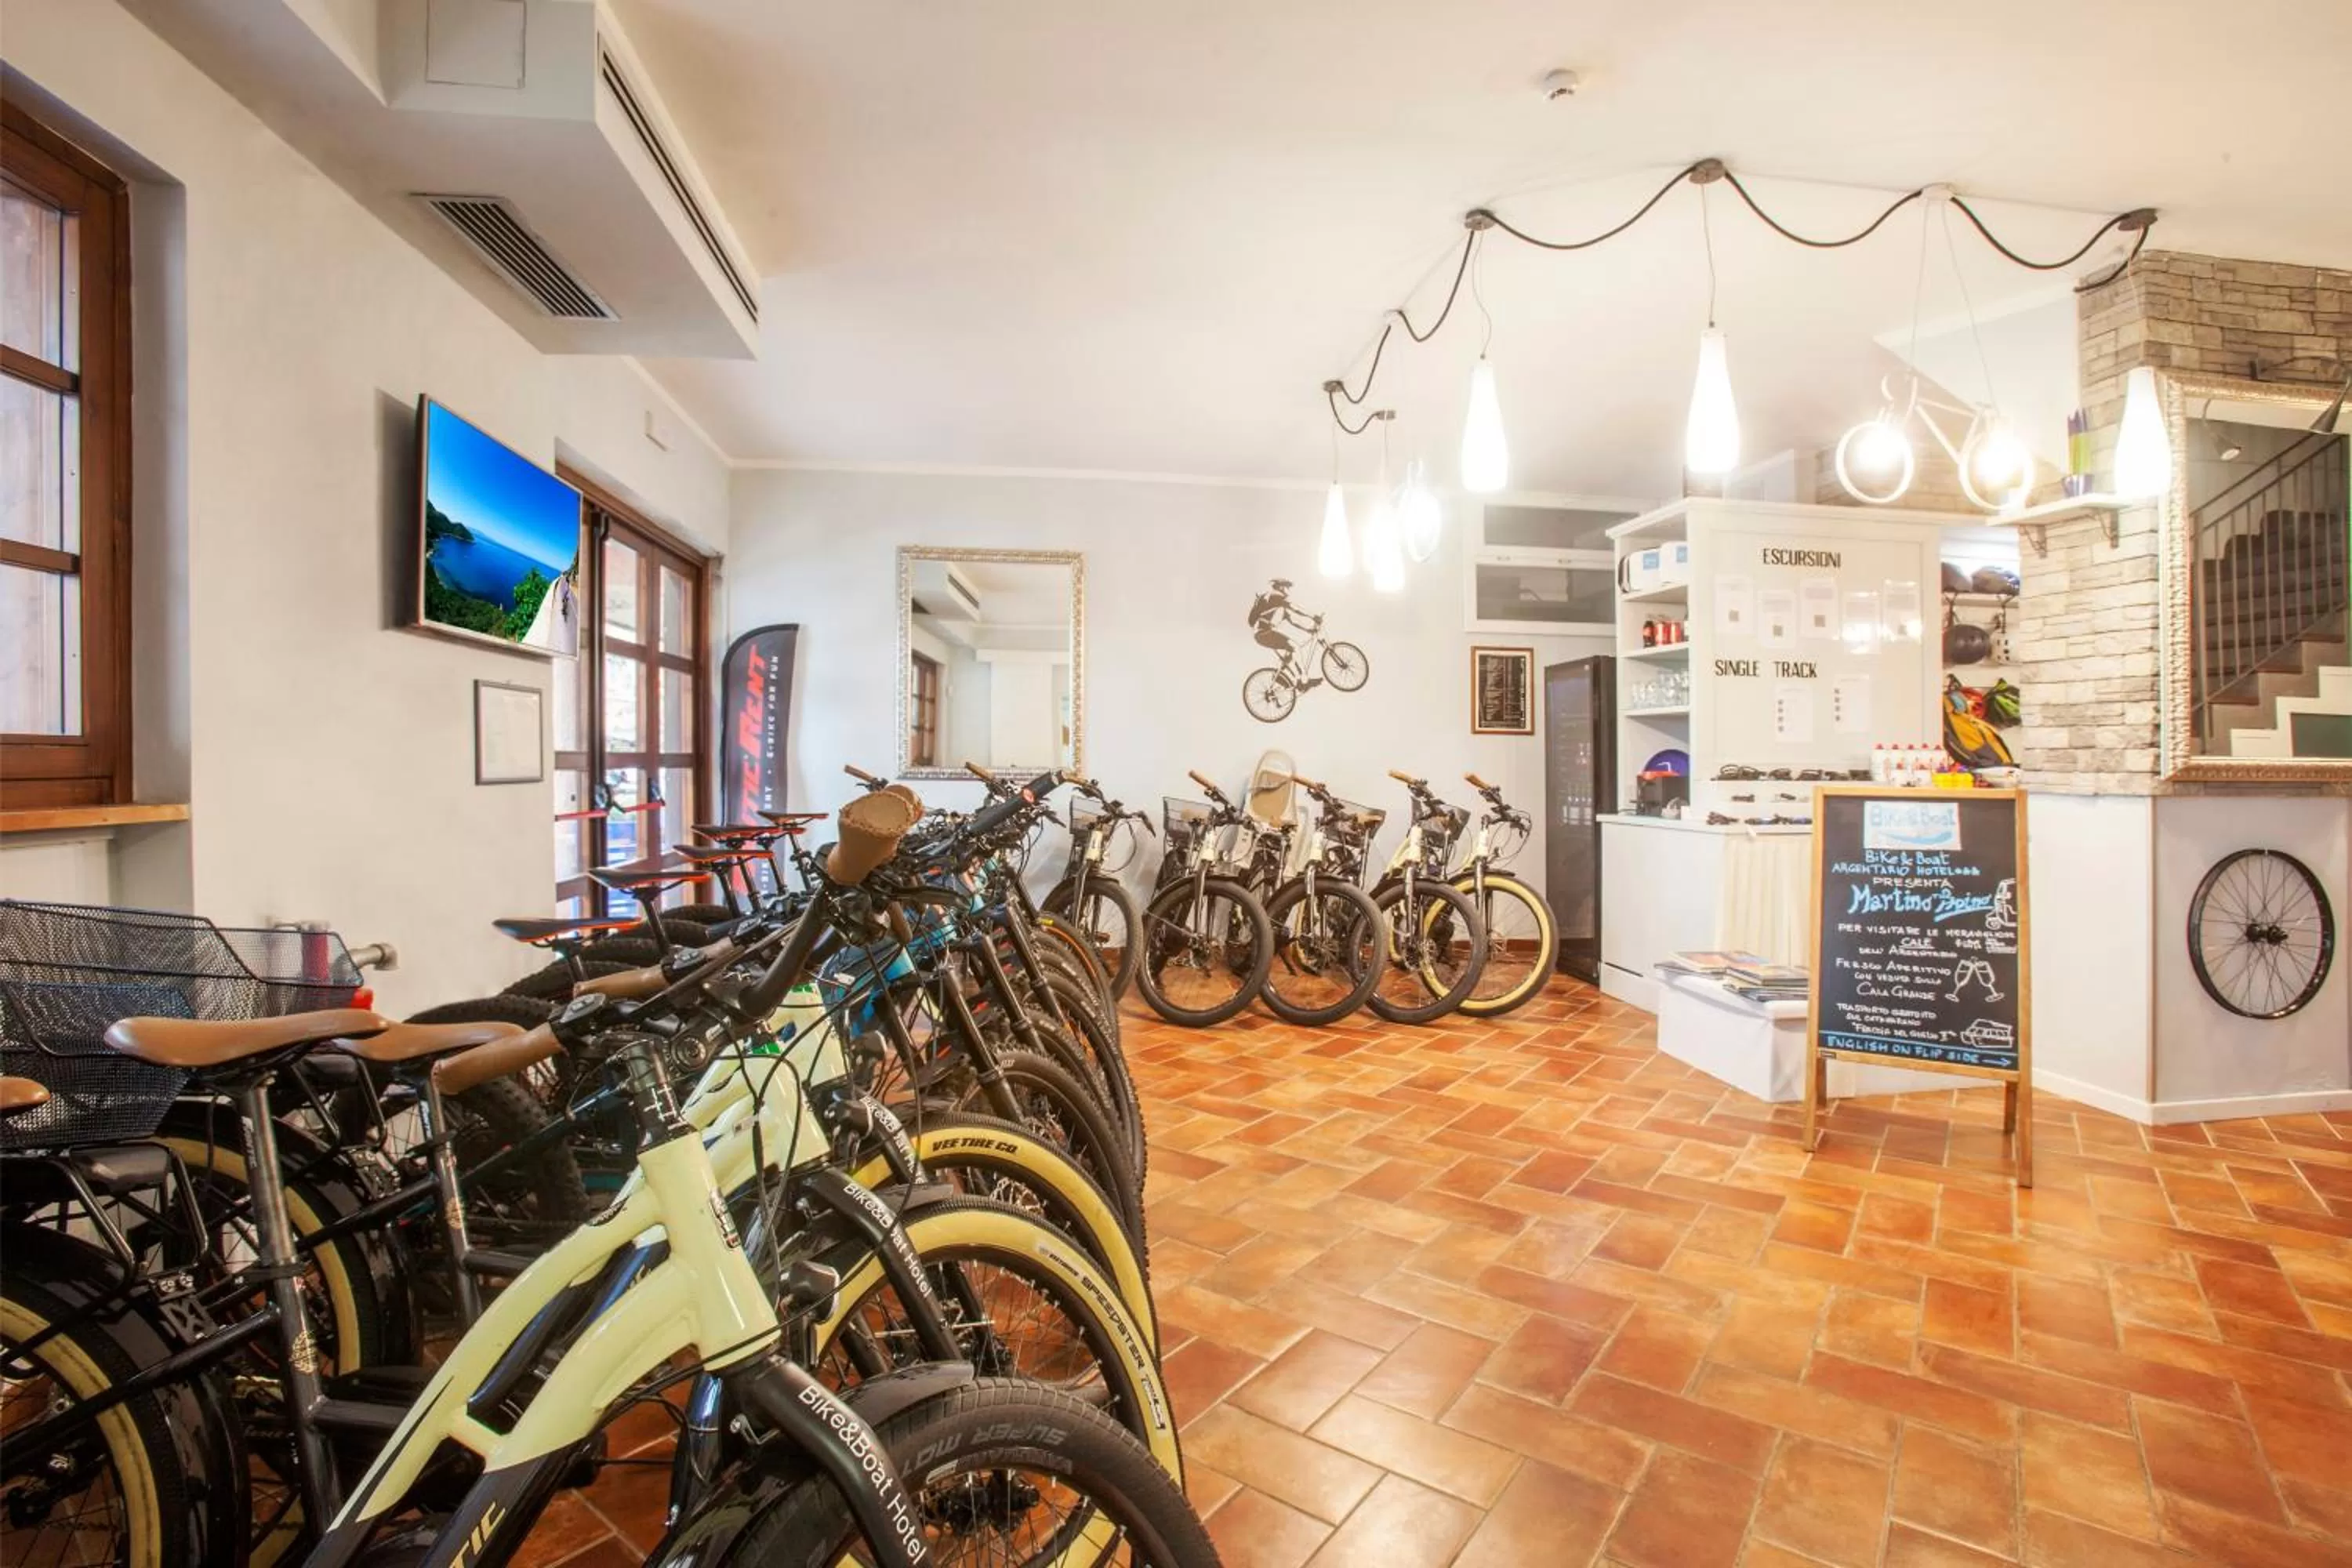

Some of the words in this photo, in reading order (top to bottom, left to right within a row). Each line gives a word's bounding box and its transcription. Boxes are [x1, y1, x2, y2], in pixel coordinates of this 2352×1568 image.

[1763, 548, 1842, 568] ESCURSIONI
[1715, 659, 1759, 677] SINGLE
[1773, 661, 1818, 678] TRACK
[1872, 877, 1955, 889] PRESENTA
[1847, 884, 1933, 915] Martino
[1838, 923, 1863, 934] PER
[1866, 925, 1921, 936] VISITARE
[1856, 981, 1889, 997] CALA
[1891, 985, 1936, 1001] GRANDE
[1827, 1036, 1889, 1053] ENGLISH
[1892, 1043, 1911, 1055] ON
[1915, 1045, 1944, 1059] FLIP
[1947, 1051, 1980, 1063] SIDE
[903, 1252, 933, 1298] Hotel
[1080, 1276, 1145, 1370] SPEEDSTER
[970, 1422, 1068, 1446] SUPER
[797, 1385, 895, 1497] Bike&Boat
[886, 1491, 927, 1566] Hotel
